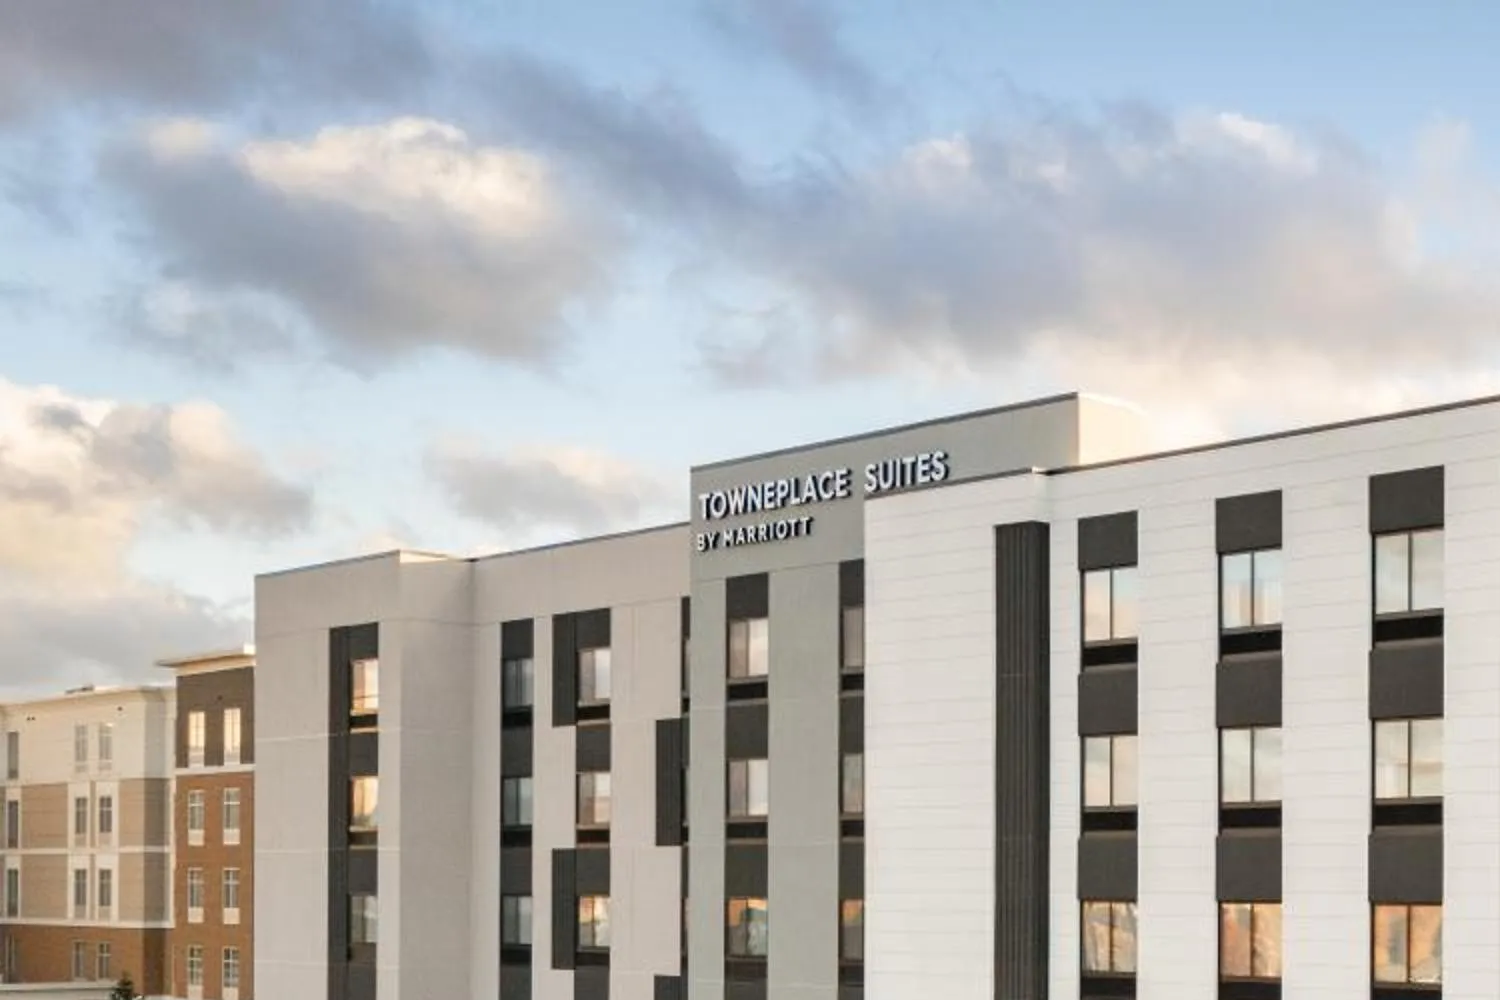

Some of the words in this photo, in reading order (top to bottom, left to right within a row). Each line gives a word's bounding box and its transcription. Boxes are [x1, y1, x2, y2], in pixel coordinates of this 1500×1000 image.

[699, 468, 852, 521] TOWNEPLACE
[864, 451, 949, 494] SUITES
[697, 531, 721, 552] BY
[724, 516, 813, 548] MARRIOTT
